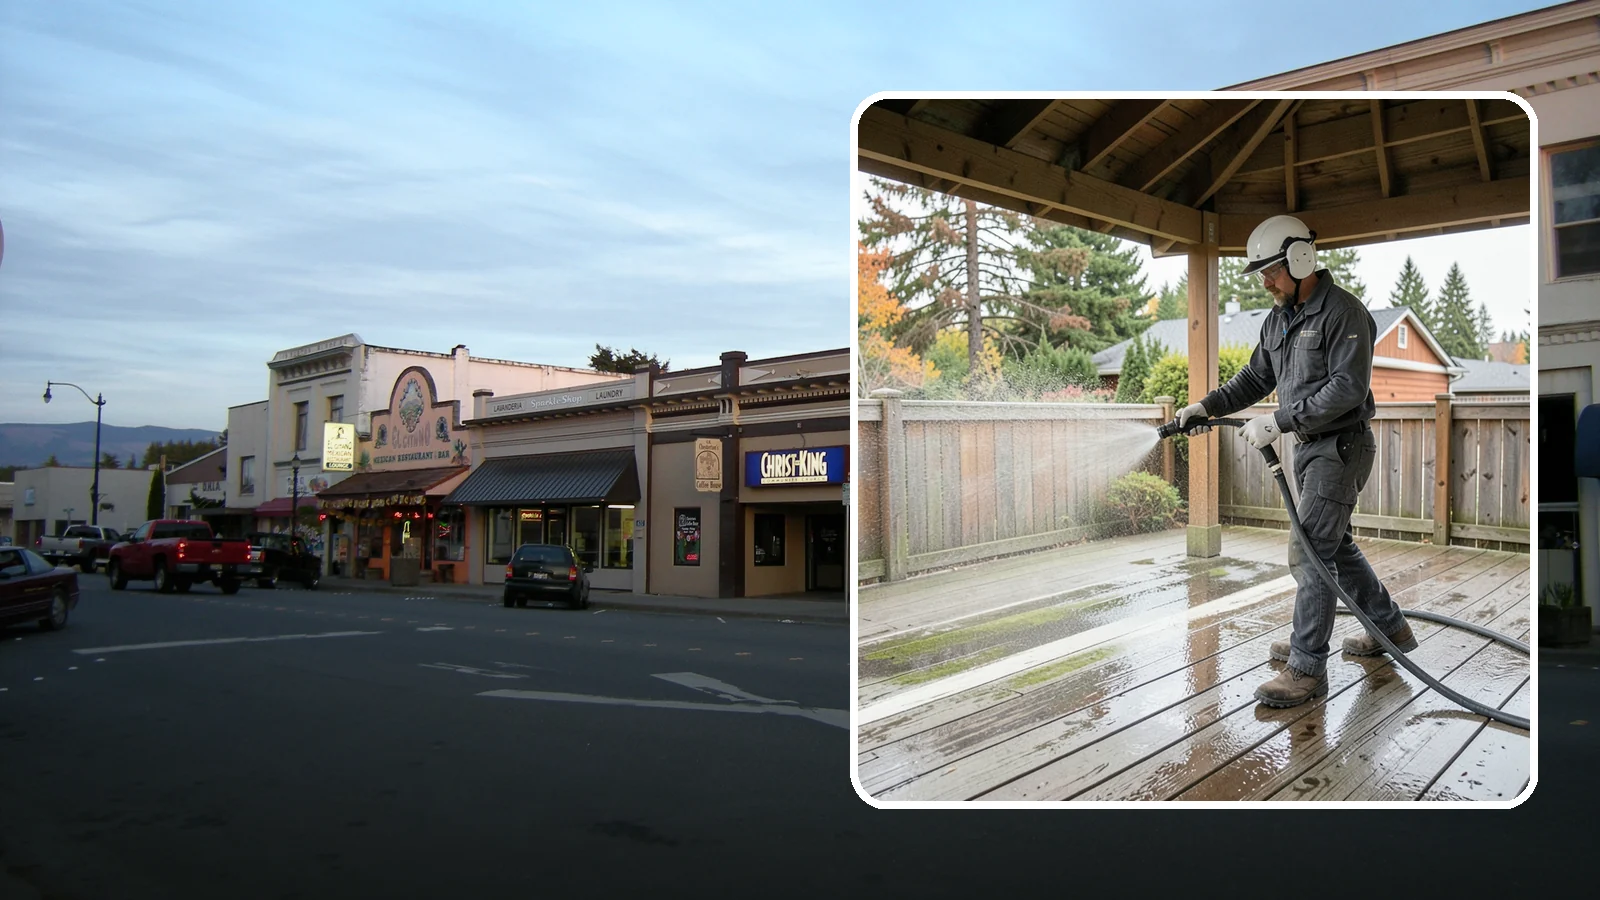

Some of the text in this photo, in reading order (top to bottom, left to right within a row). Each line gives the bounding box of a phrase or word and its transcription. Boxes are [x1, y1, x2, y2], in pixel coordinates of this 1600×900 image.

[562, 394, 582, 404] Shop
[595, 388, 623, 400] LAUNDRY
[493, 401, 522, 413] LAVANDERIA
[374, 455, 396, 464] MEXICAN
[397, 451, 433, 462] RESTAURANT
[438, 450, 450, 459] BAR
[761, 449, 827, 478] CHRIST KING
